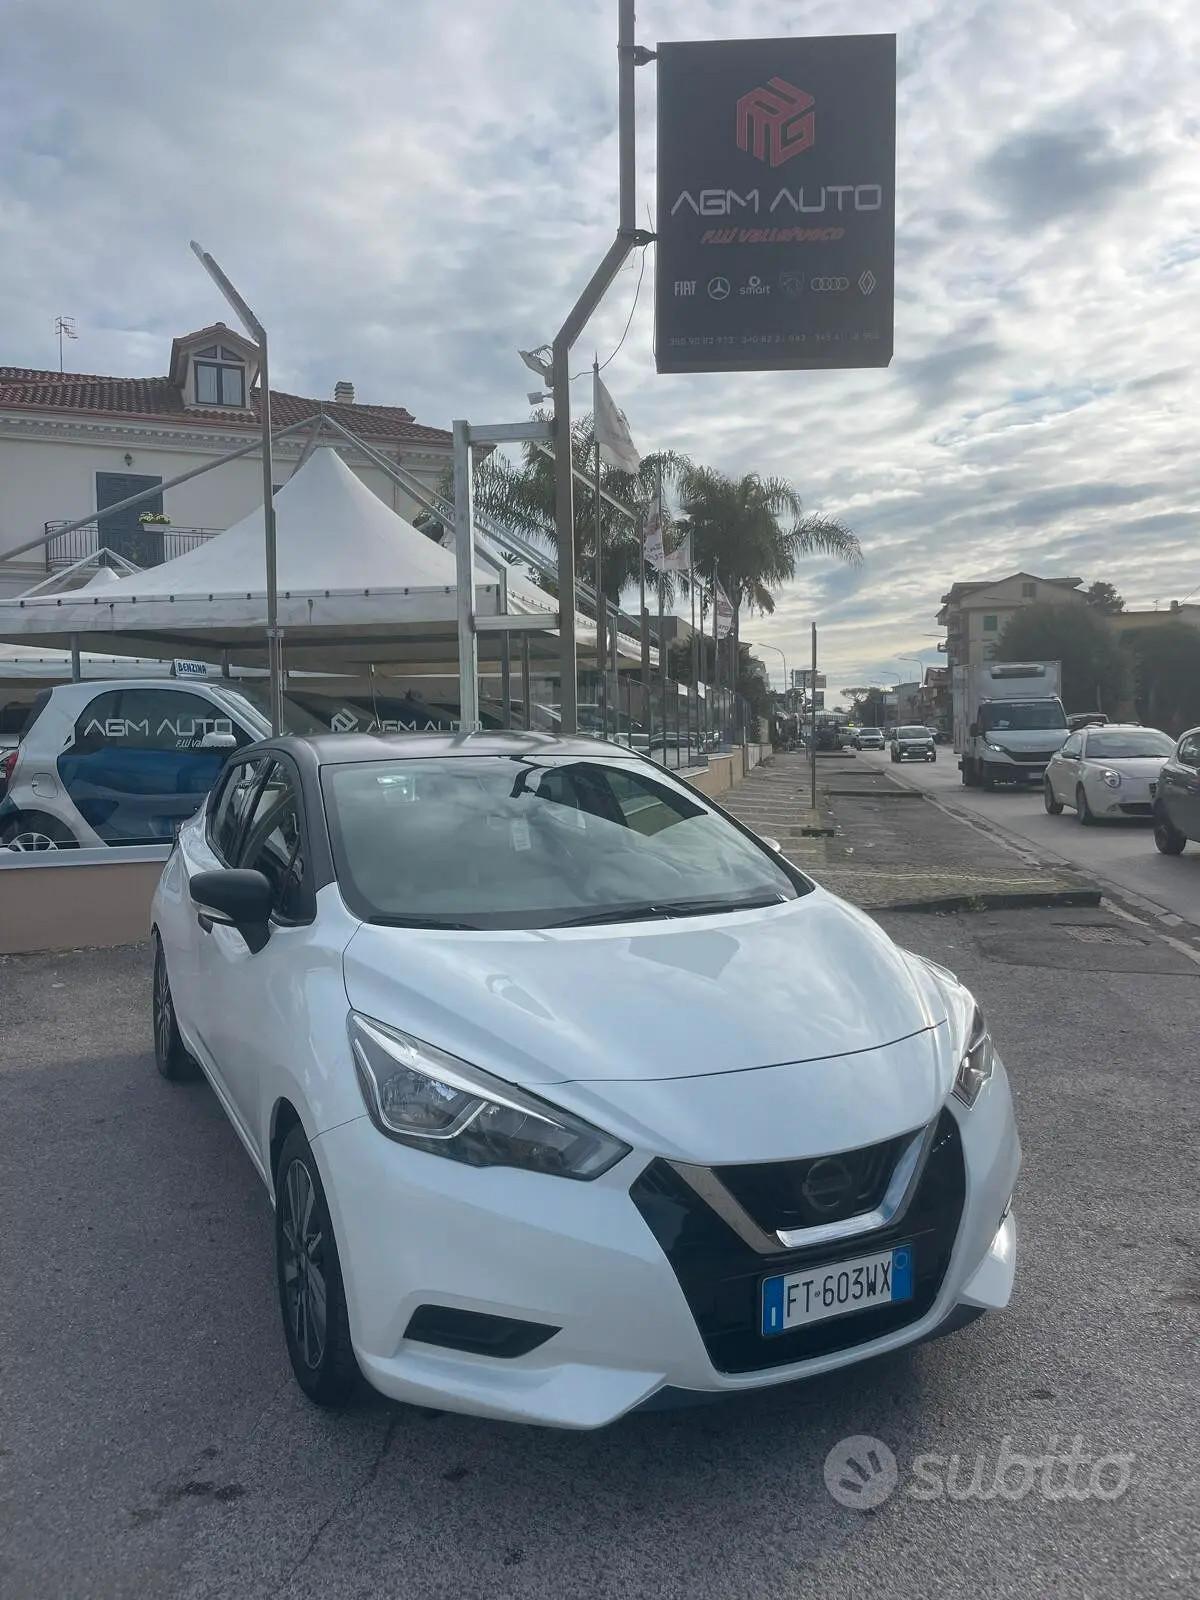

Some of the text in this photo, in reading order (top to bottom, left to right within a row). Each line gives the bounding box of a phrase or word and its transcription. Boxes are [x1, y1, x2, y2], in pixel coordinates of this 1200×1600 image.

[671, 184, 882, 216] AGM AUTO
[673, 280, 697, 297] FIAT
[739, 285, 771, 295] smart
[177, 662, 207, 674] BENZINA
[84, 718, 233, 737] AGM AUTO
